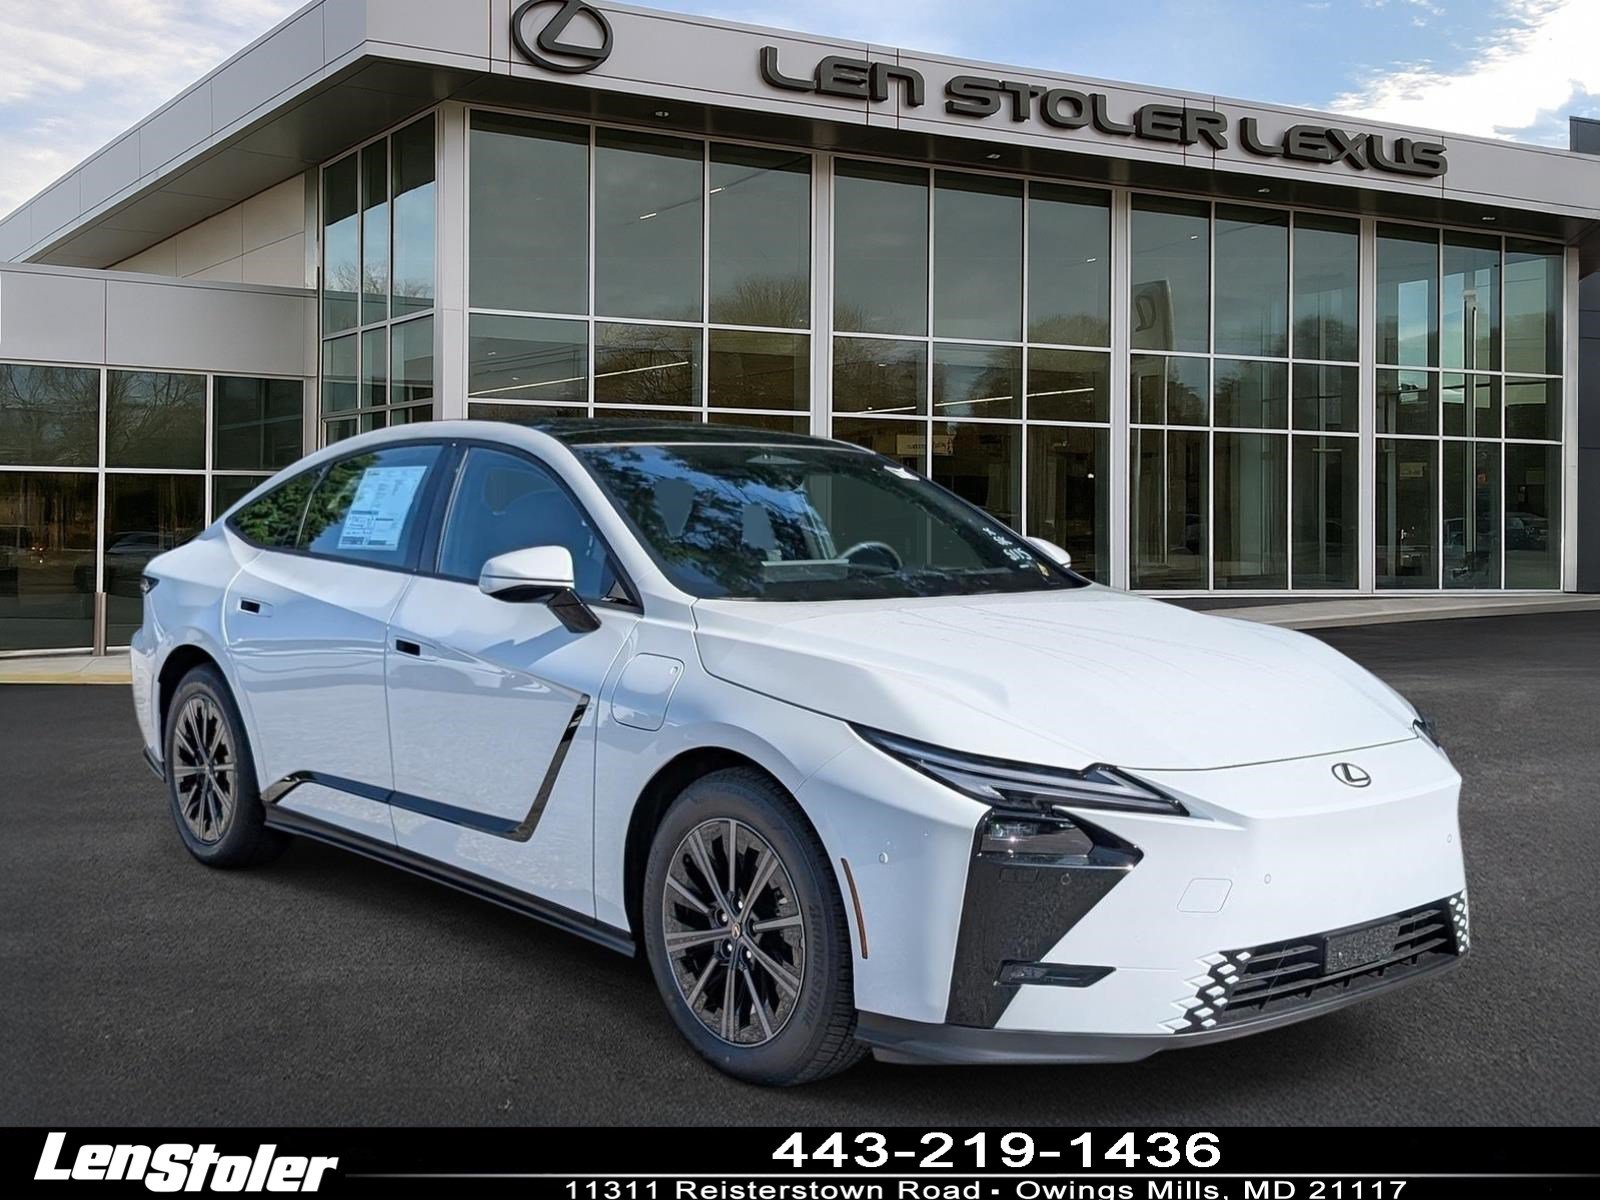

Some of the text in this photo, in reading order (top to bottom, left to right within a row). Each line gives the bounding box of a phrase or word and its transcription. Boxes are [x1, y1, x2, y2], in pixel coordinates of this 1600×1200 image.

[760, 46, 1448, 178] LEN STOLER LEXUS
